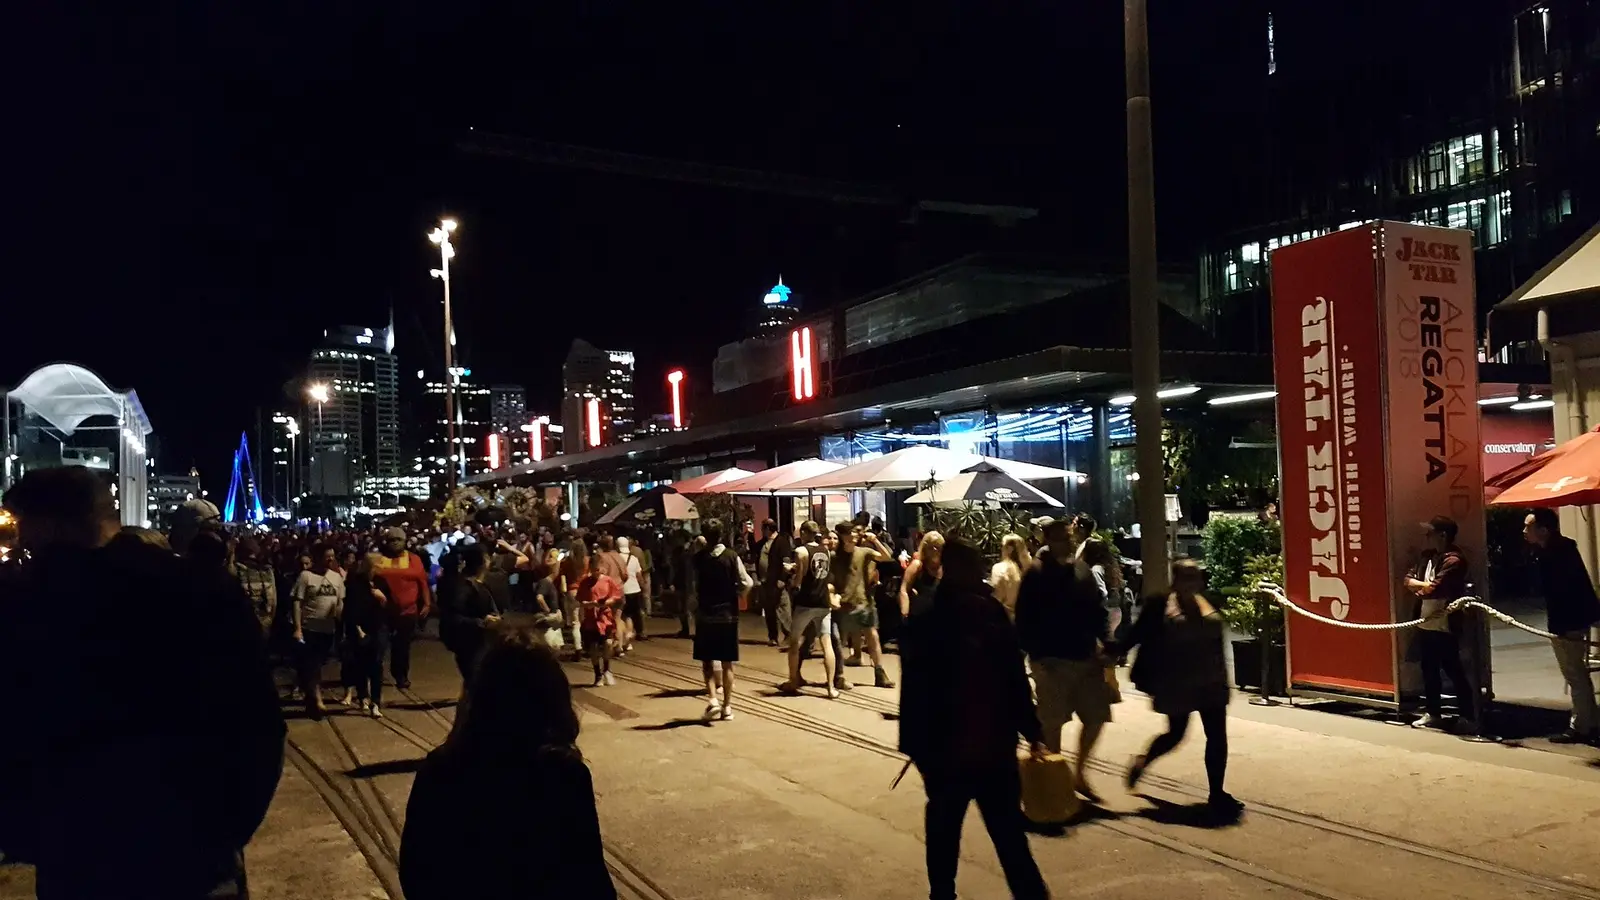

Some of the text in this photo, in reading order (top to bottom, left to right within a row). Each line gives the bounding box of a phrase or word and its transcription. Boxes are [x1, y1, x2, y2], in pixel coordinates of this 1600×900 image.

[1396, 237, 1461, 262] JACK
[1408, 264, 1457, 283] TAR
[1396, 294, 1420, 379] 2018
[1420, 296, 1447, 483] REGATTA
[1301, 297, 1350, 620] JACK TAR
[1341, 358, 1362, 550] NORTH WHARF
[1443, 297, 1471, 518] AUCKLAND
[1484, 442, 1537, 456] conservatory
